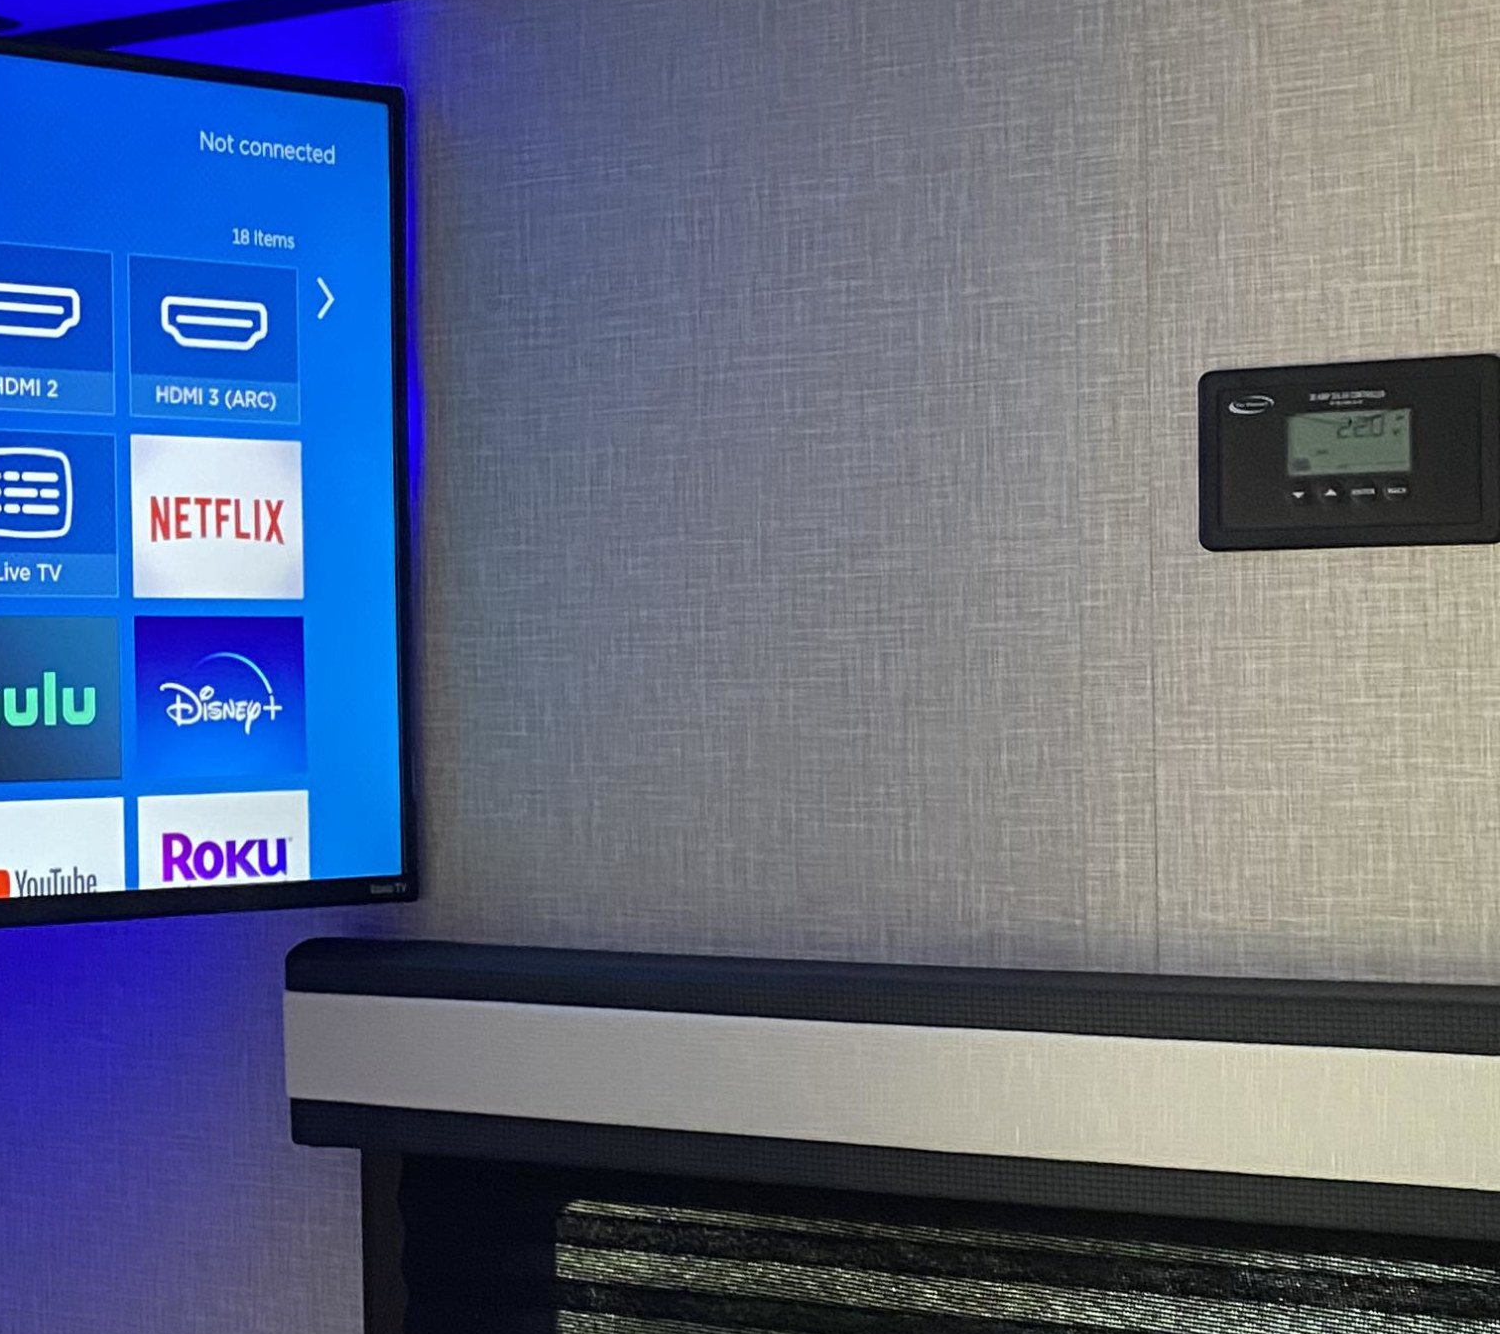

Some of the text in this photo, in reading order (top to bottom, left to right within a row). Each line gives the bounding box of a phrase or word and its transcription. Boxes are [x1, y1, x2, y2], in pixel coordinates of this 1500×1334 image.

[199, 130, 336, 165] Not connected
[232, 228, 296, 250] 18 Items
[46, 379, 59, 398] 2
[156, 385, 277, 412] HDMI 3 (ARC)
[150, 495, 285, 545] NETFLIX
[36, 563, 63, 582] TV
[14, 865, 98, 898] YouTube
